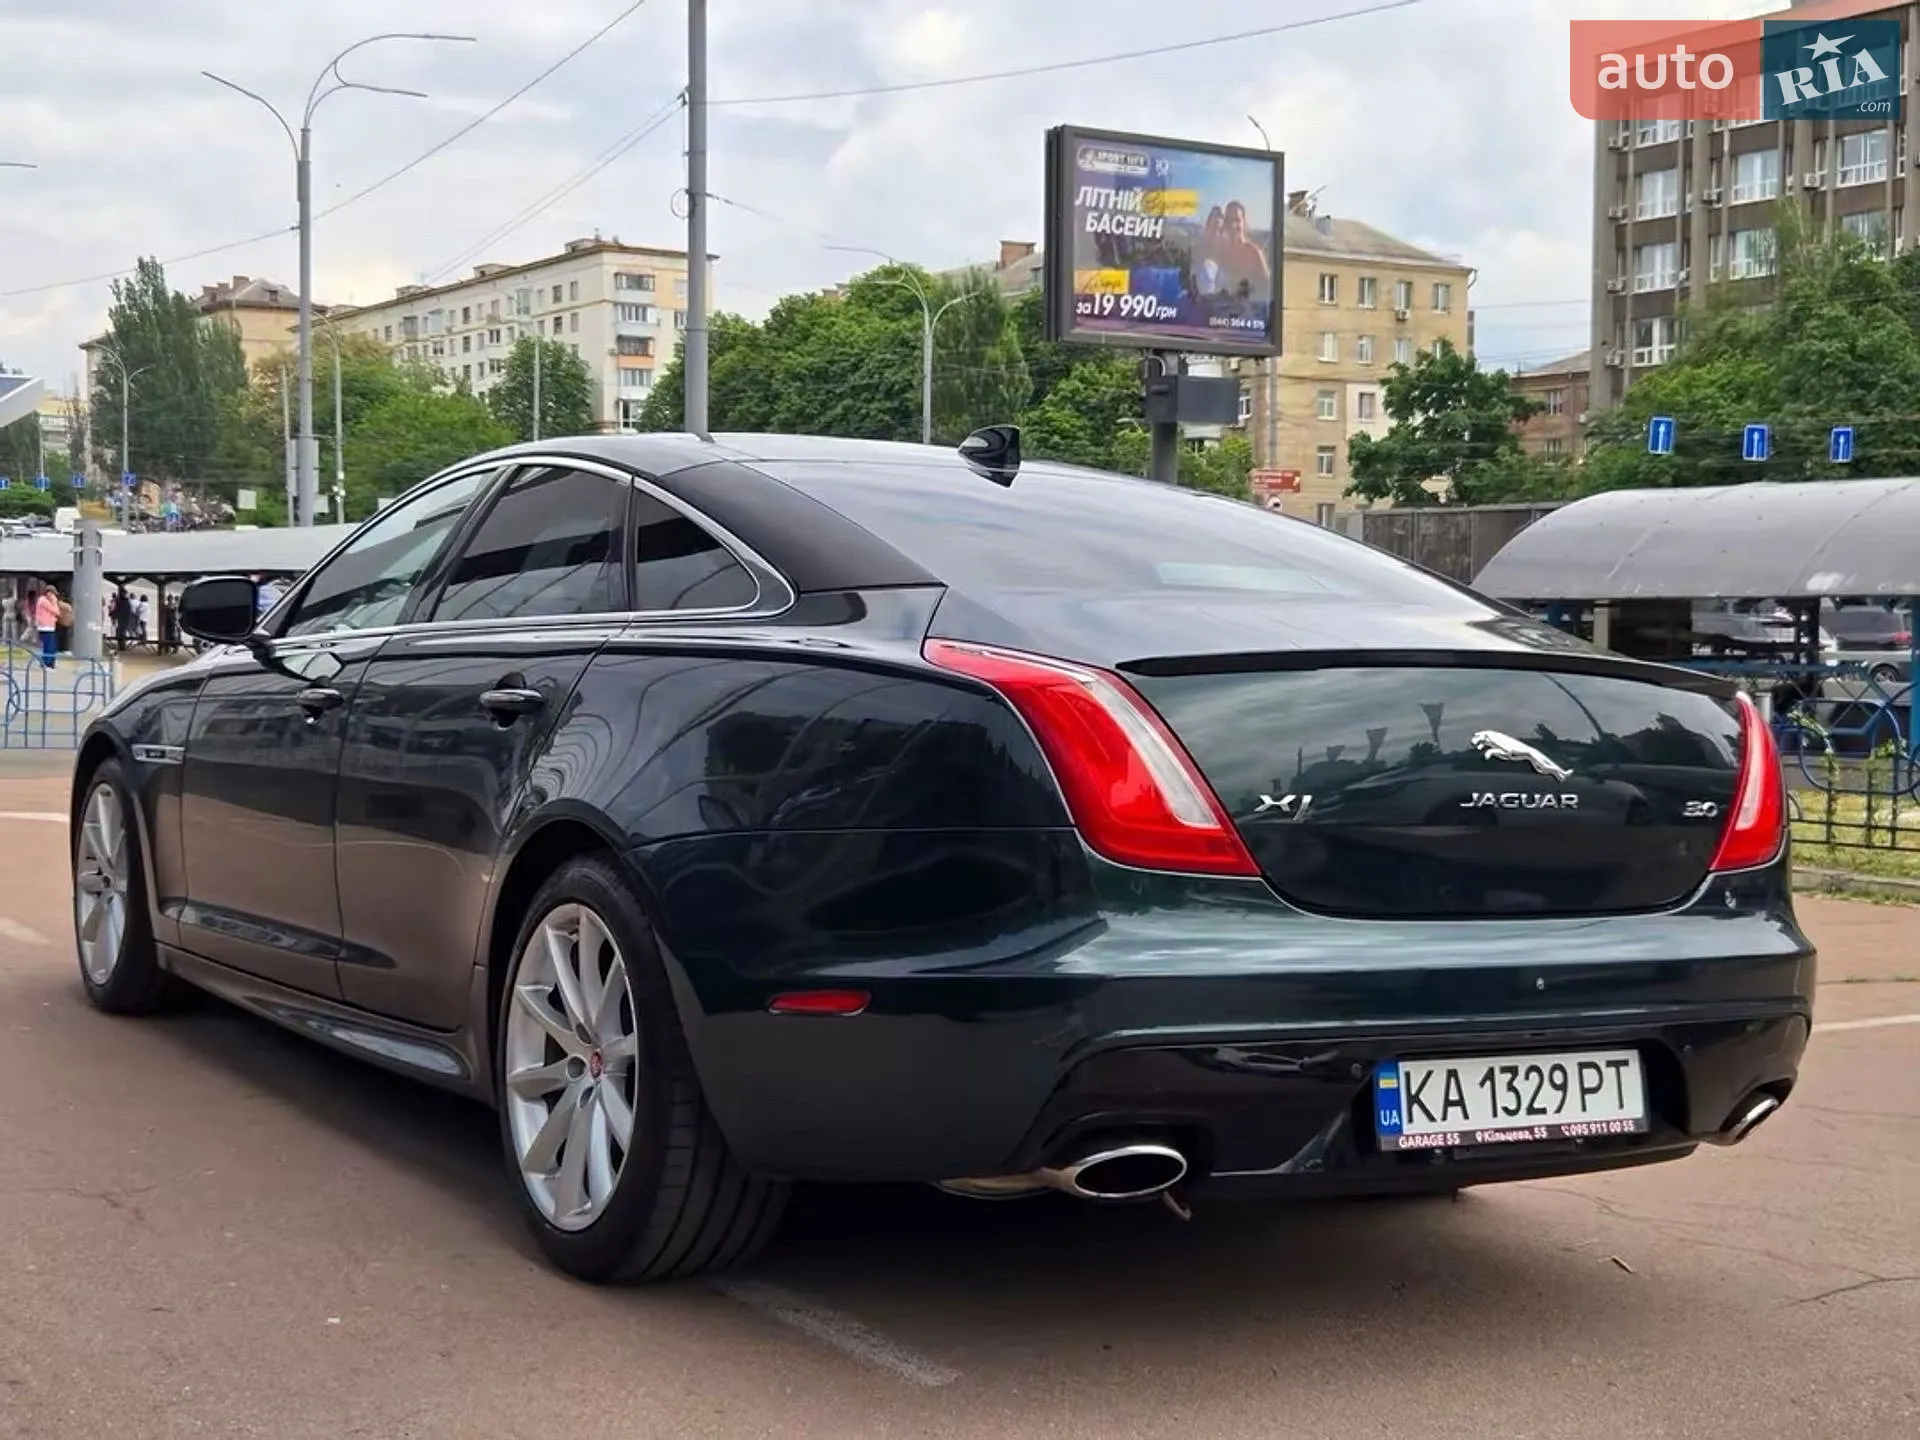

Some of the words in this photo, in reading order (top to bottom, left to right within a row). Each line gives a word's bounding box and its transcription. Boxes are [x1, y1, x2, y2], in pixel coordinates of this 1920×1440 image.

[1075, 186, 1143, 213] ЛІТНІЙ
[1254, 794, 1313, 821] XJ
[1460, 792, 1579, 808] JAGUAR
[1479, 1062, 1569, 1118] 1329
[1380, 1109, 1401, 1126] UA
[1399, 1134, 1445, 1149] GARAGE
[1445, 1132, 1460, 1146] 55
[1534, 1126, 1548, 1139] 55
